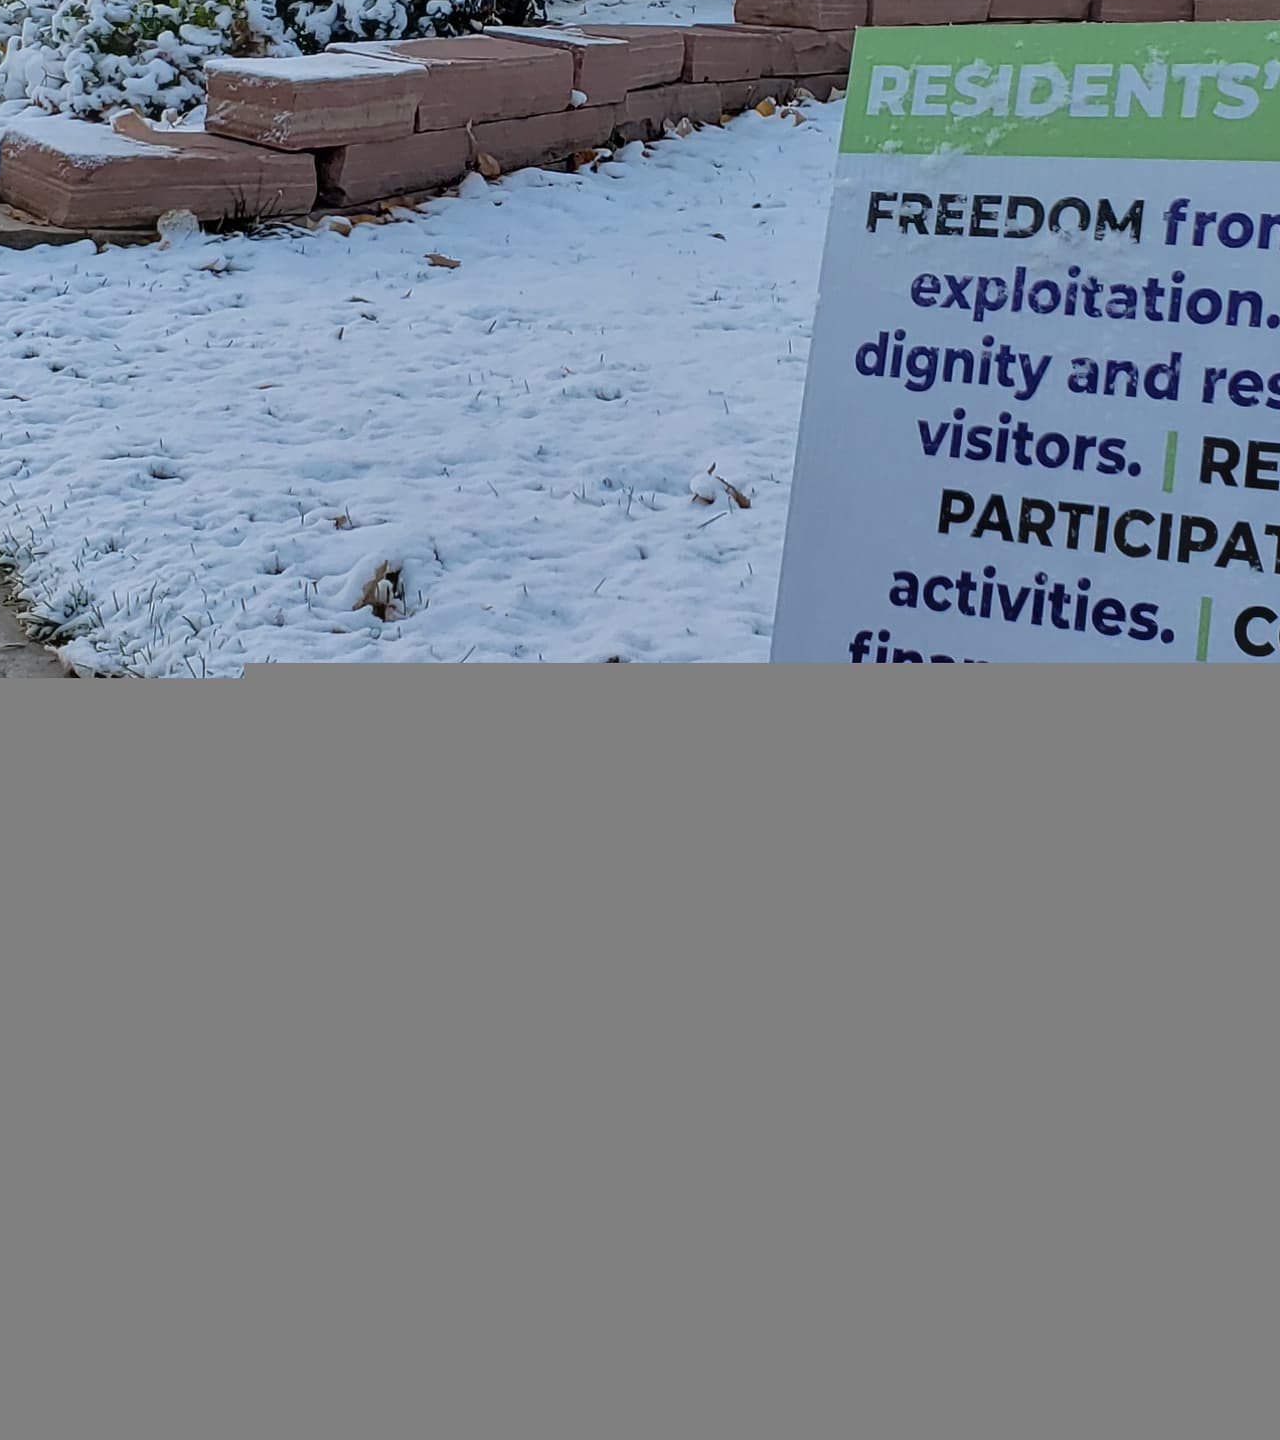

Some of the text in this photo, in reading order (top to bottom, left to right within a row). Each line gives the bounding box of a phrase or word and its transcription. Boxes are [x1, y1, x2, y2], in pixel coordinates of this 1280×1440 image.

[865, 191, 1146, 244] FREEDOM
[909, 264, 1280, 330] exploitation.
[854, 327, 1053, 401] dignity
[1066, 350, 1183, 402] and
[916, 406, 1142, 478] visitors.
[888, 564, 1176, 645] activities.
